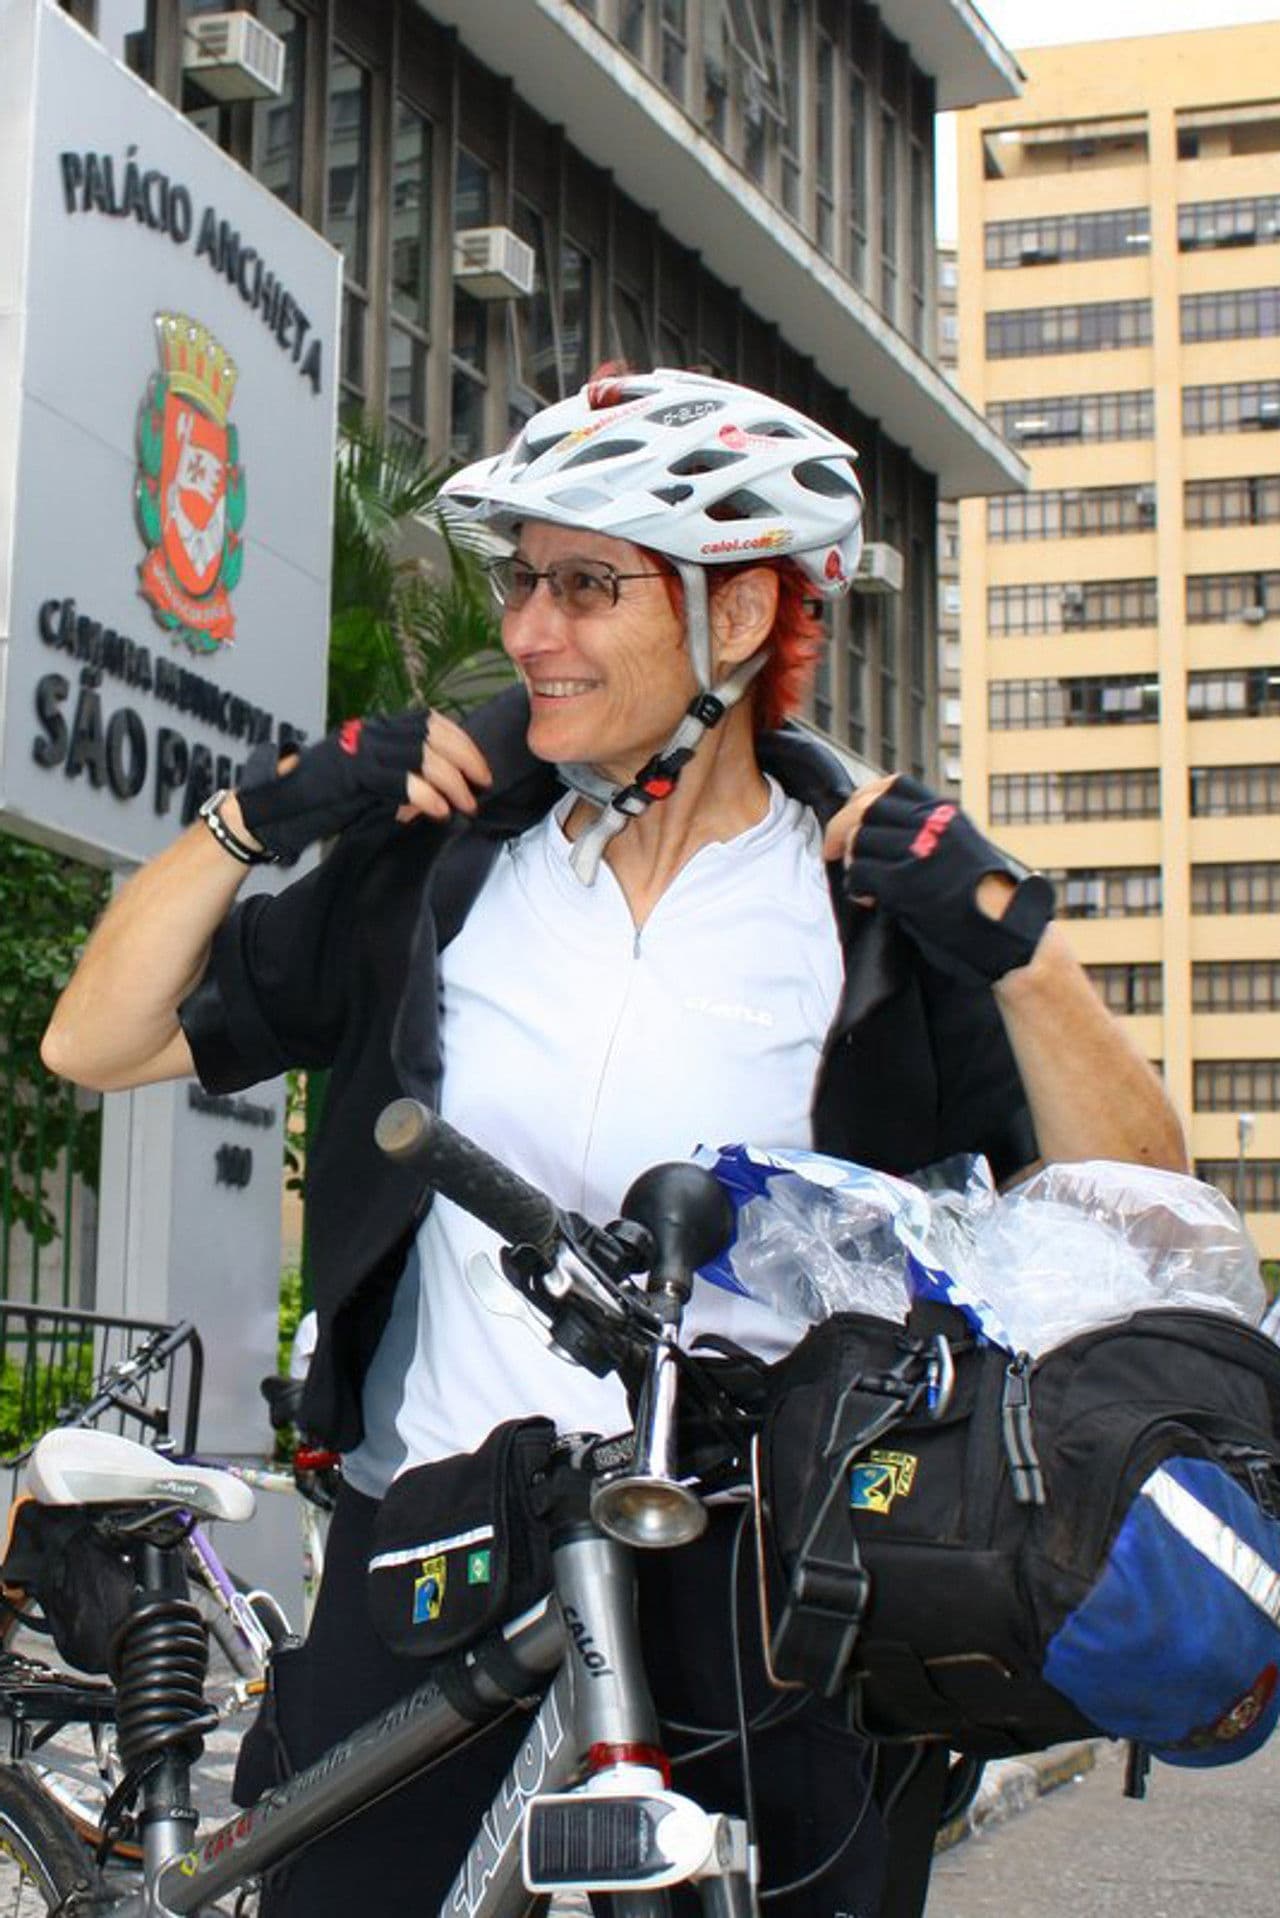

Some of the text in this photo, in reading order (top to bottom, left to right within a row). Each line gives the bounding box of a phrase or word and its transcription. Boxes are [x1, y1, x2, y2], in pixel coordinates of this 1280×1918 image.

[60, 144, 322, 395] PALÁCIO ANCHIETA
[33, 666, 148, 801] SÃO
[562, 1605, 615, 1679] CALOI
